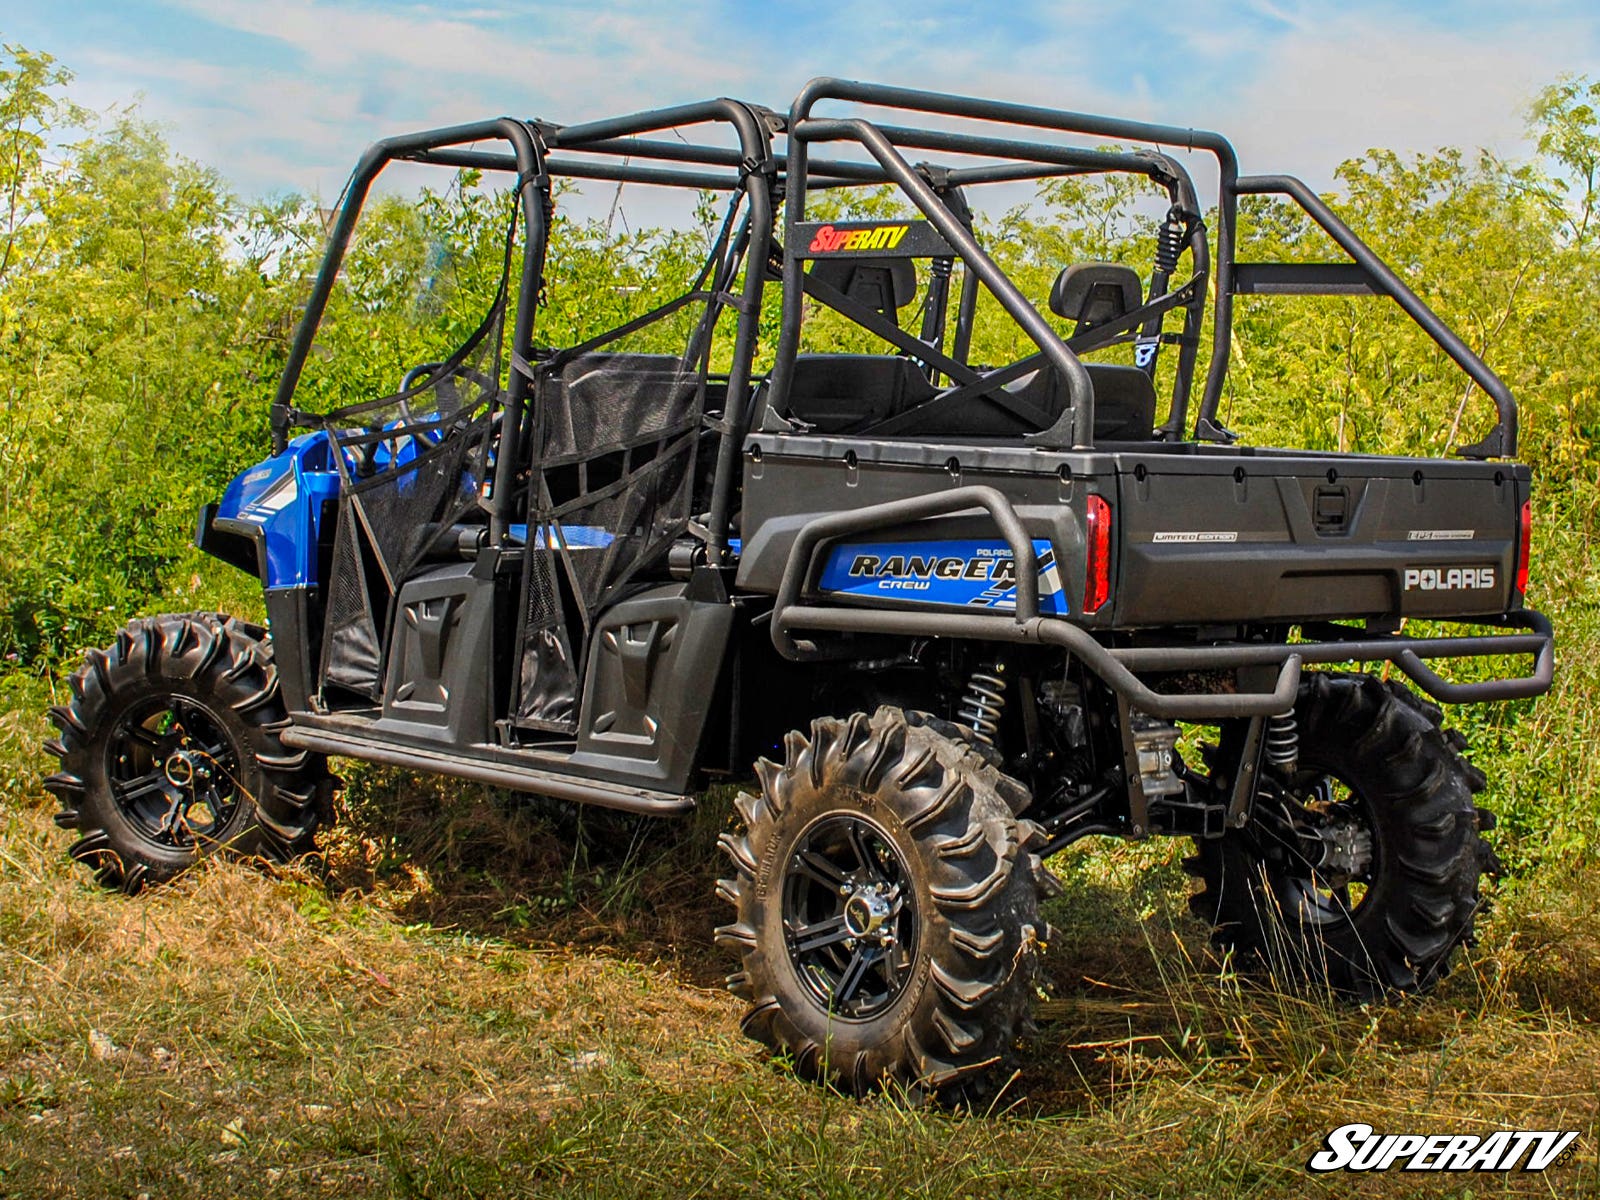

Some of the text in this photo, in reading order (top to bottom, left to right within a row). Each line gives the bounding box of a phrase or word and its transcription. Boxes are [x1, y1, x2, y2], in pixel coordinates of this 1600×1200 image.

[810, 225, 909, 252] SUPERATV
[976, 548, 1013, 557] POLARIS
[849, 554, 1016, 582] RANGER
[1404, 568, 1495, 591] POLARIS
[878, 579, 931, 590] CREW
